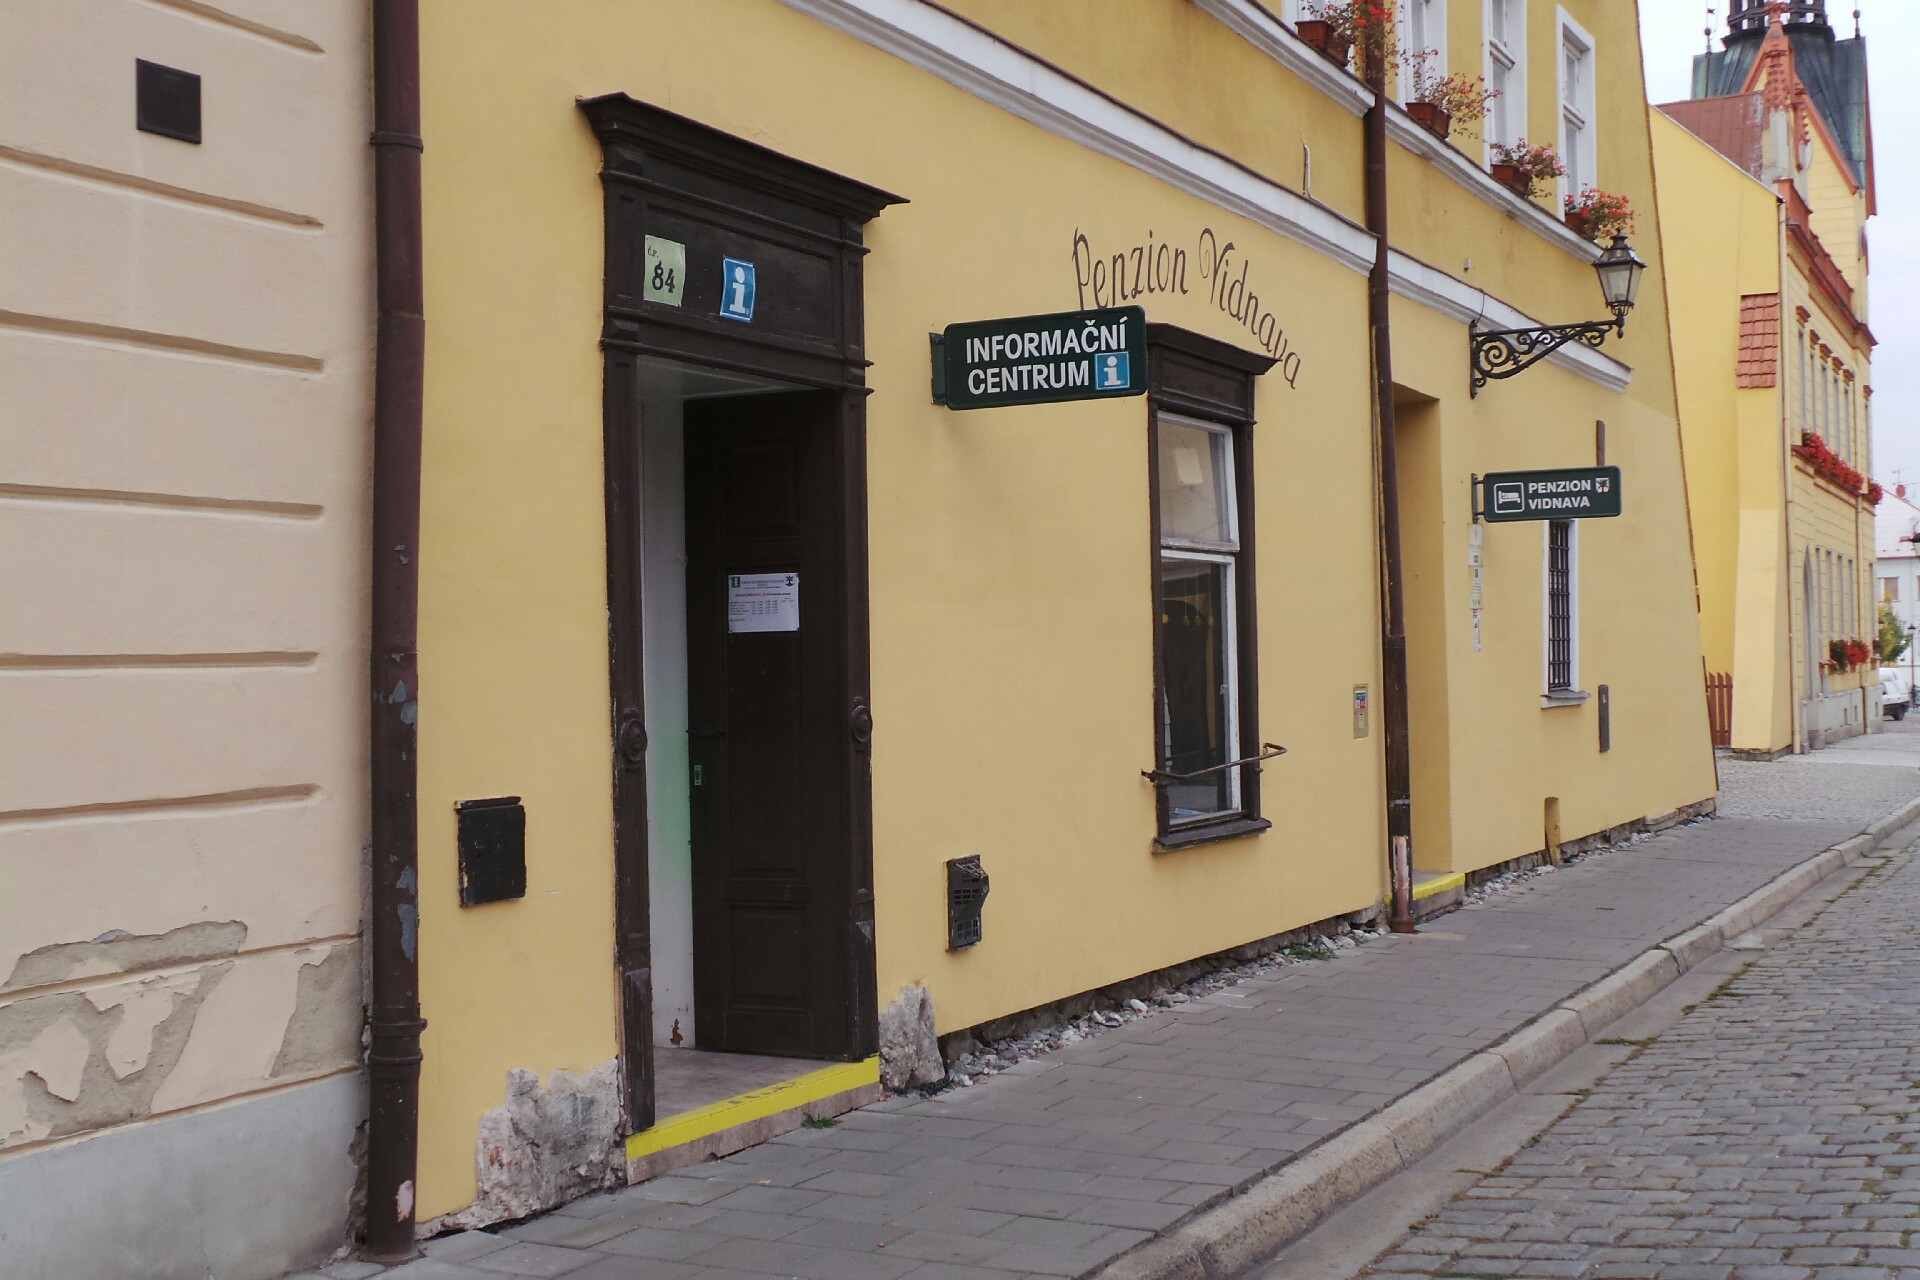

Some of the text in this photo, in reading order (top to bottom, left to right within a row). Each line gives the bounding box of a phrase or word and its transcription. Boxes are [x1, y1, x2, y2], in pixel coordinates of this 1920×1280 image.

[652, 260, 675, 294] 84
[1072, 226, 1301, 390] Penzion Vidnava
[966, 315, 1128, 364] INFORMAČNÍ
[967, 360, 1089, 395] CENTRUM
[1528, 479, 1591, 494] PENZION
[1528, 496, 1591, 510] VIDNAVA
